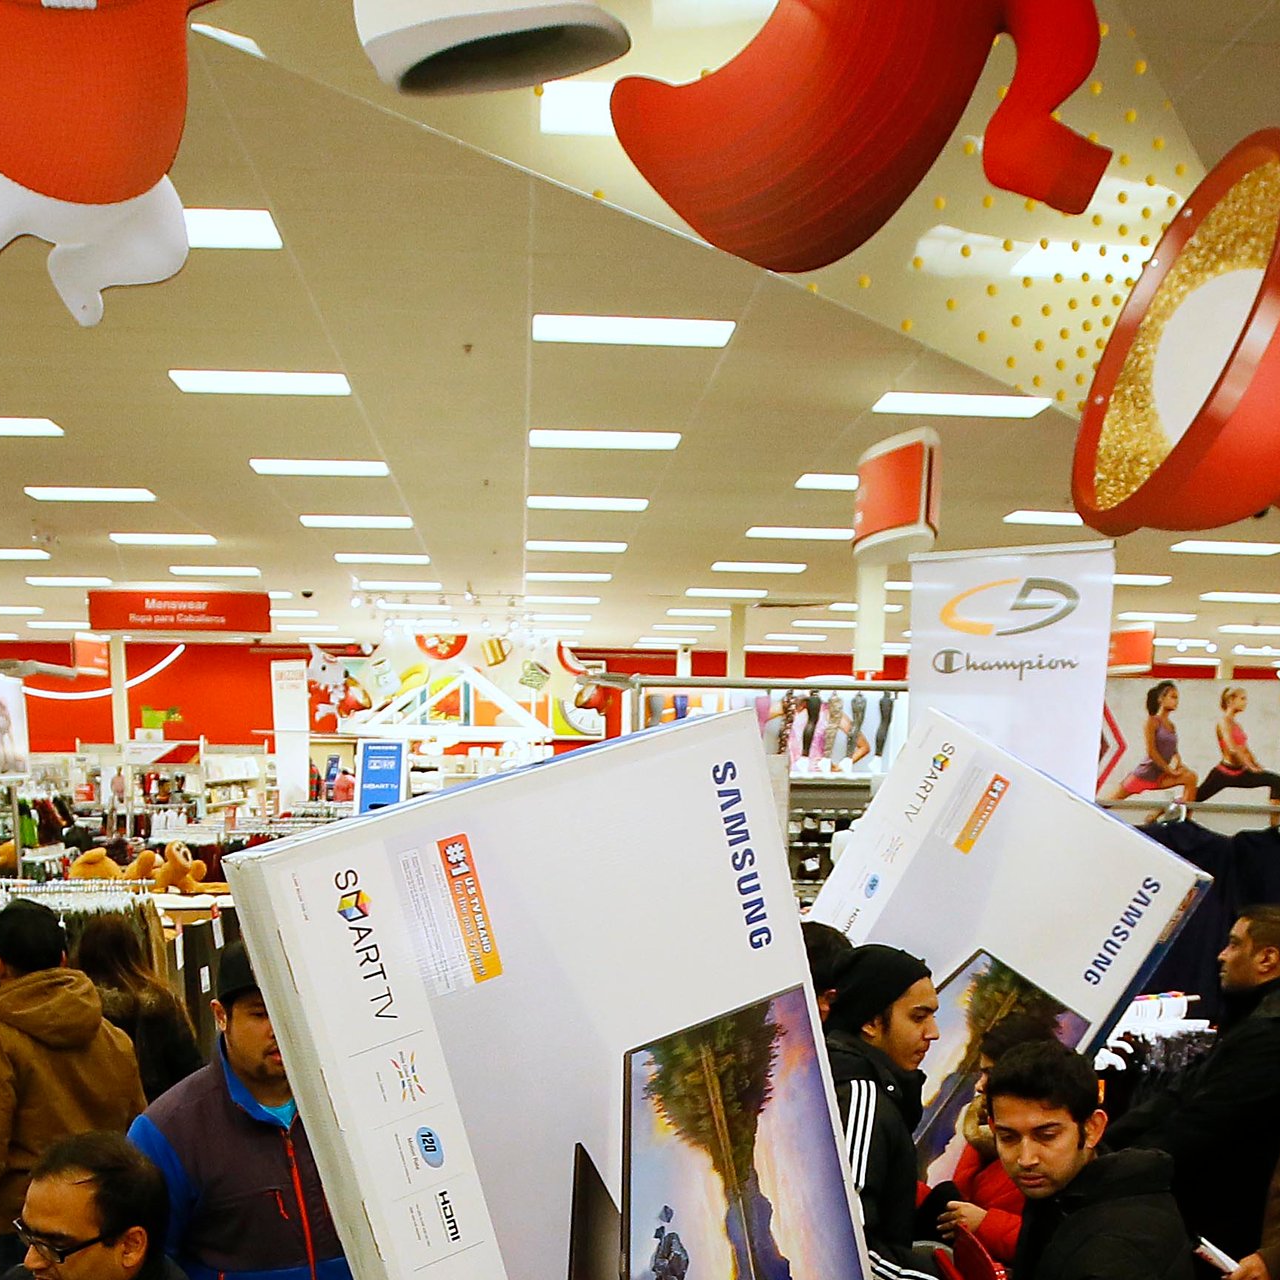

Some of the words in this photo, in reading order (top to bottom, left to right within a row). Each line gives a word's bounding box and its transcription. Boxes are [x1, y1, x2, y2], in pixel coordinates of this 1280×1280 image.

[128, 612, 153, 623] Ropa
[145, 597, 208, 611] Menswear
[932, 648, 1079, 680] Champion
[903, 801, 924, 824] TV
[712, 760, 773, 951] SAMSUNG
[443, 843, 471, 877] #1
[472, 913, 492, 953] BRAND
[1084, 876, 1161, 987] SAMSUNG
[369, 988, 398, 1020] TV
[419, 1130, 437, 1154] 120
[437, 1189, 461, 1242] HDMI
